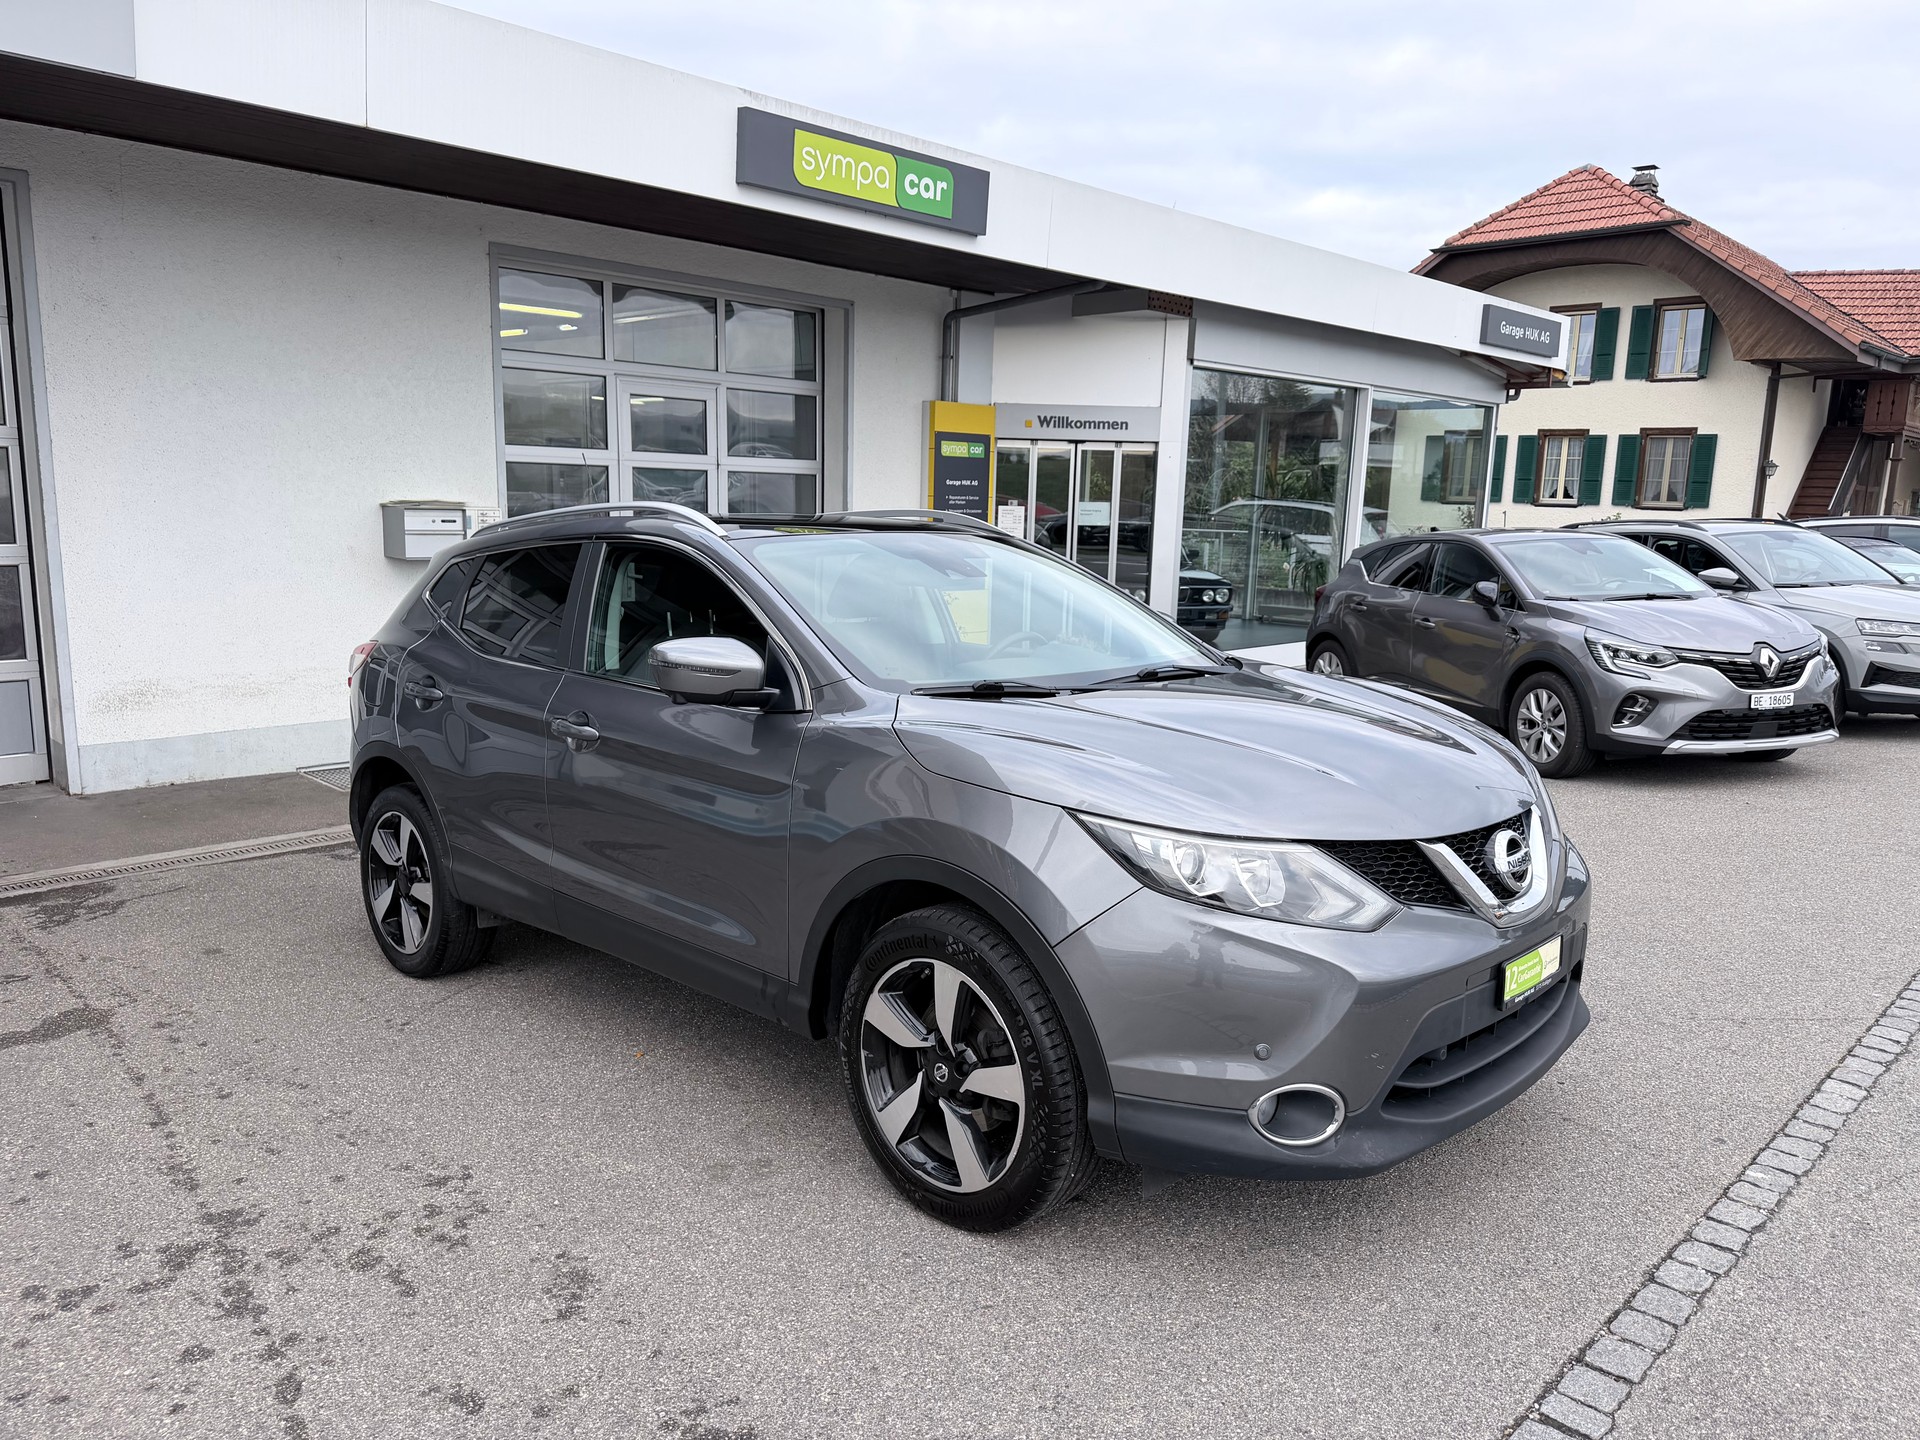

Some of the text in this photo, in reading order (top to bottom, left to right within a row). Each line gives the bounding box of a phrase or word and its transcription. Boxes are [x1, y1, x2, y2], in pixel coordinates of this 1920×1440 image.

[802, 146, 948, 202] sympa car
[1500, 320, 1550, 344] Garage HUK AG
[1038, 415, 1128, 430] Willkommen
[943, 444, 967, 454] sympa
[1754, 695, 1791, 706] BE 18605
[865, 932, 928, 972] Continental
[1505, 966, 1518, 993] 12
